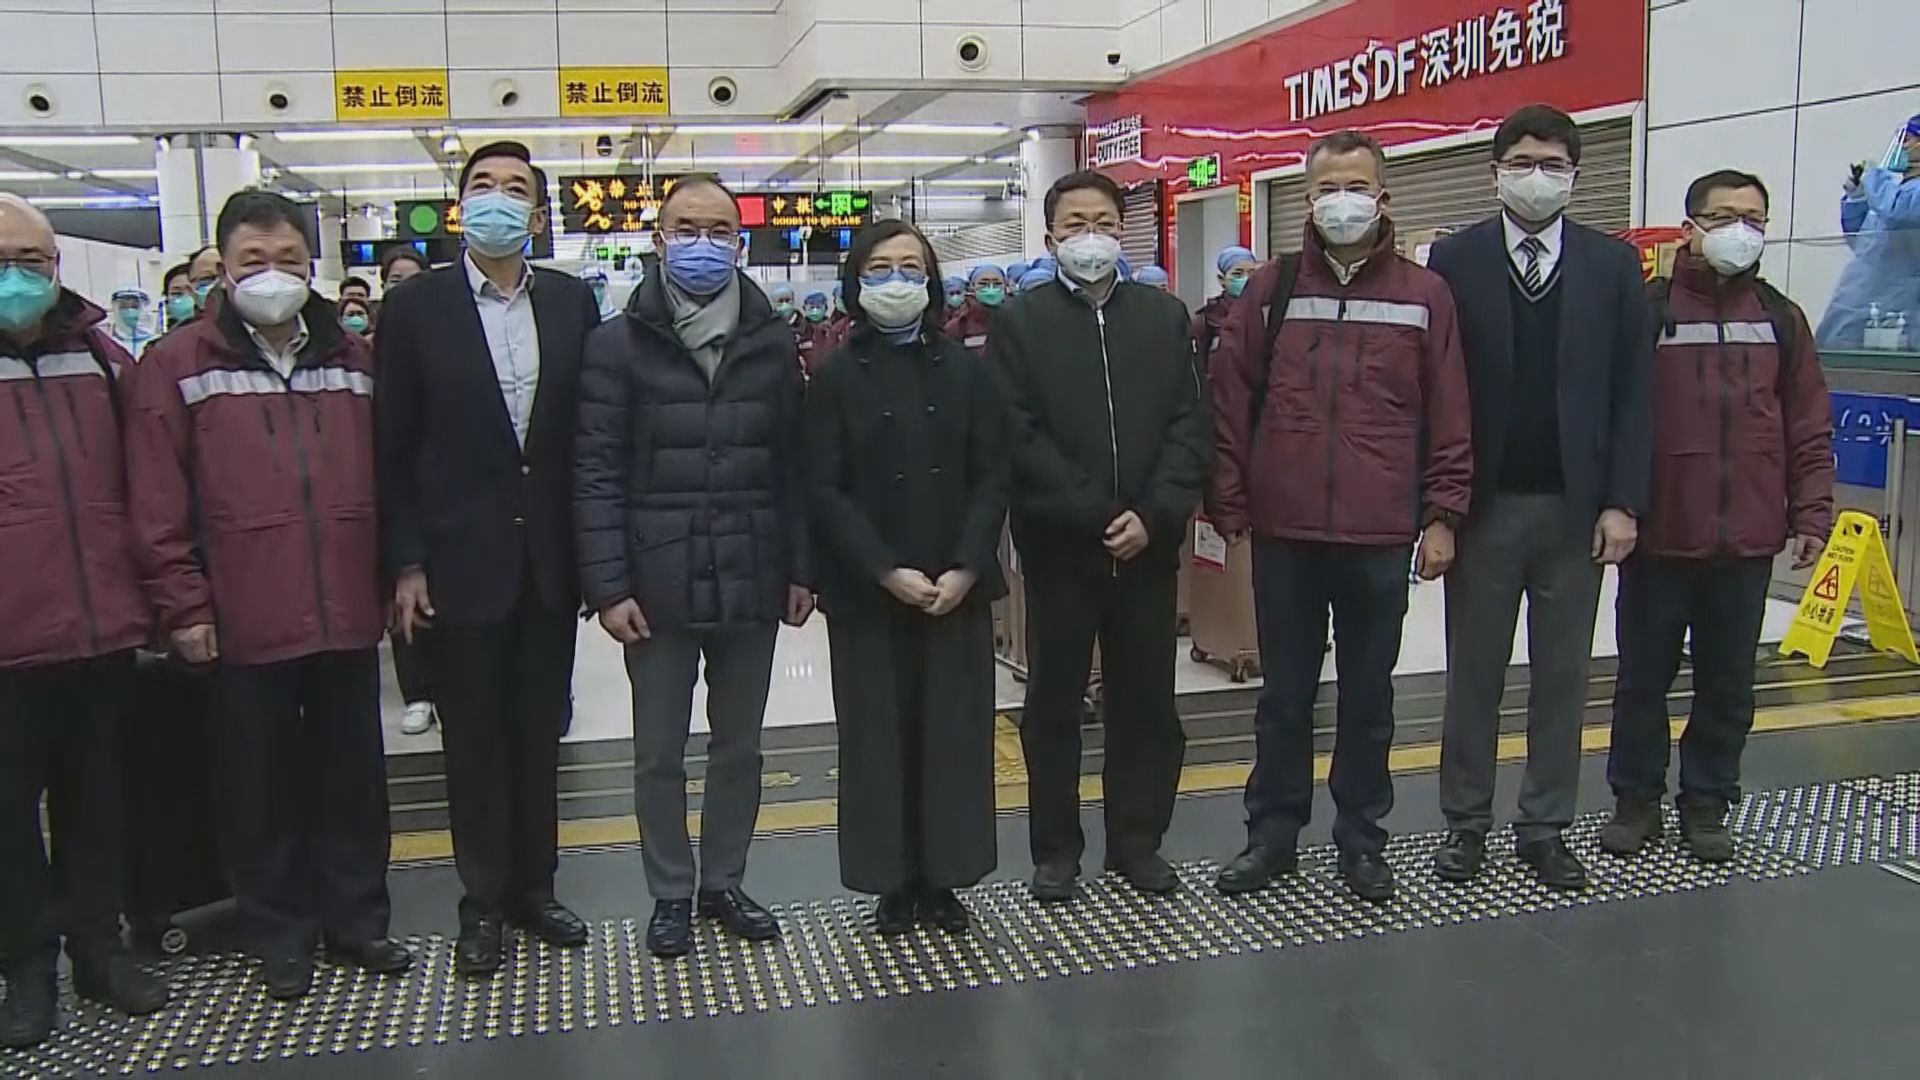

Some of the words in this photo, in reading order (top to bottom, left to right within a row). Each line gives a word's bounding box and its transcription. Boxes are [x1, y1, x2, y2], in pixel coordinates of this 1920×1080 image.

[1420, 0, 1565, 88] 深圳免税
[341, 84, 444, 108] 禁止倒流
[565, 81, 665, 105] 禁止倒流
[1097, 141, 1118, 162] DUTY
[1119, 136, 1139, 158] FREE
